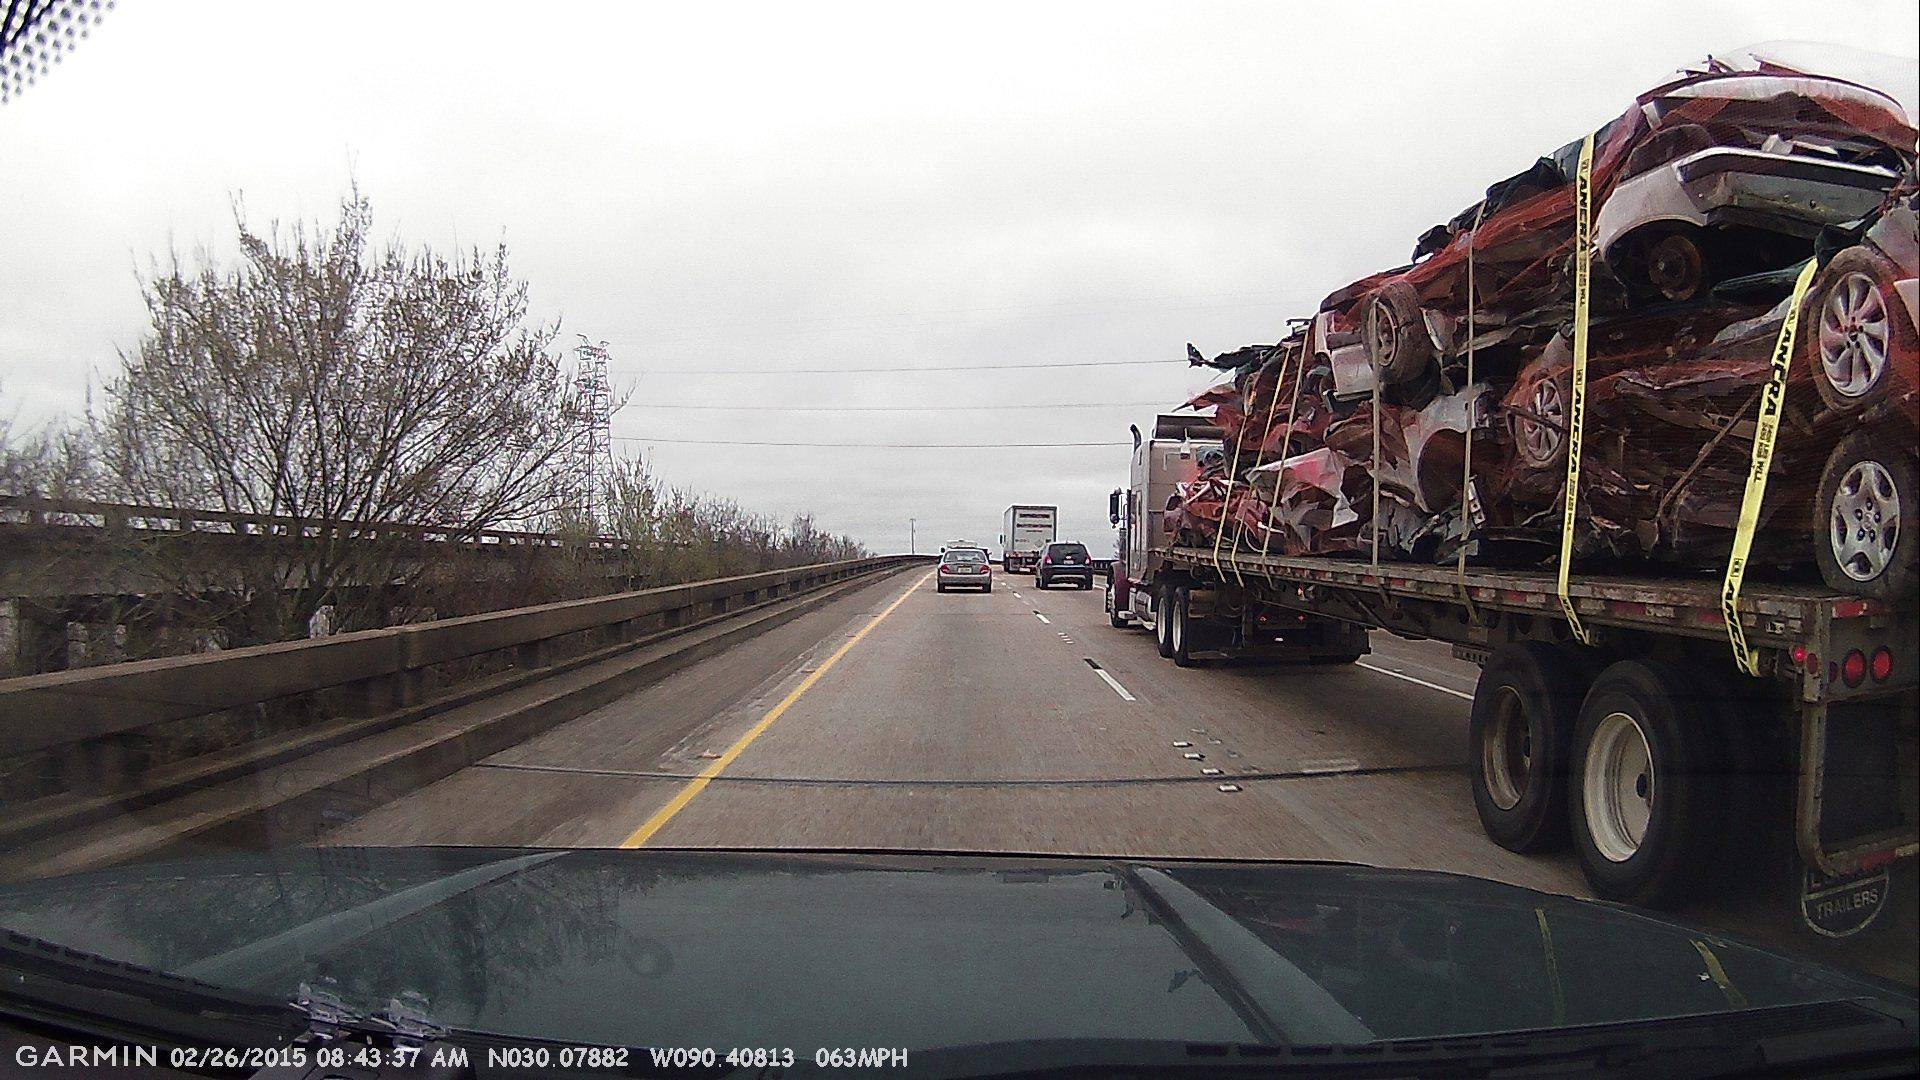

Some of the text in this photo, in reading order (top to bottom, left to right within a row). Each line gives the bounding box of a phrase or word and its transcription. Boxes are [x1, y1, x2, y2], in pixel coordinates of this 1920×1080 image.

[1578, 175, 1588, 251] ANCRA
[1765, 326, 1791, 416] ANCRA
[1571, 387, 1583, 474] ANCRA
[1816, 889, 1878, 919] TRAILERS
